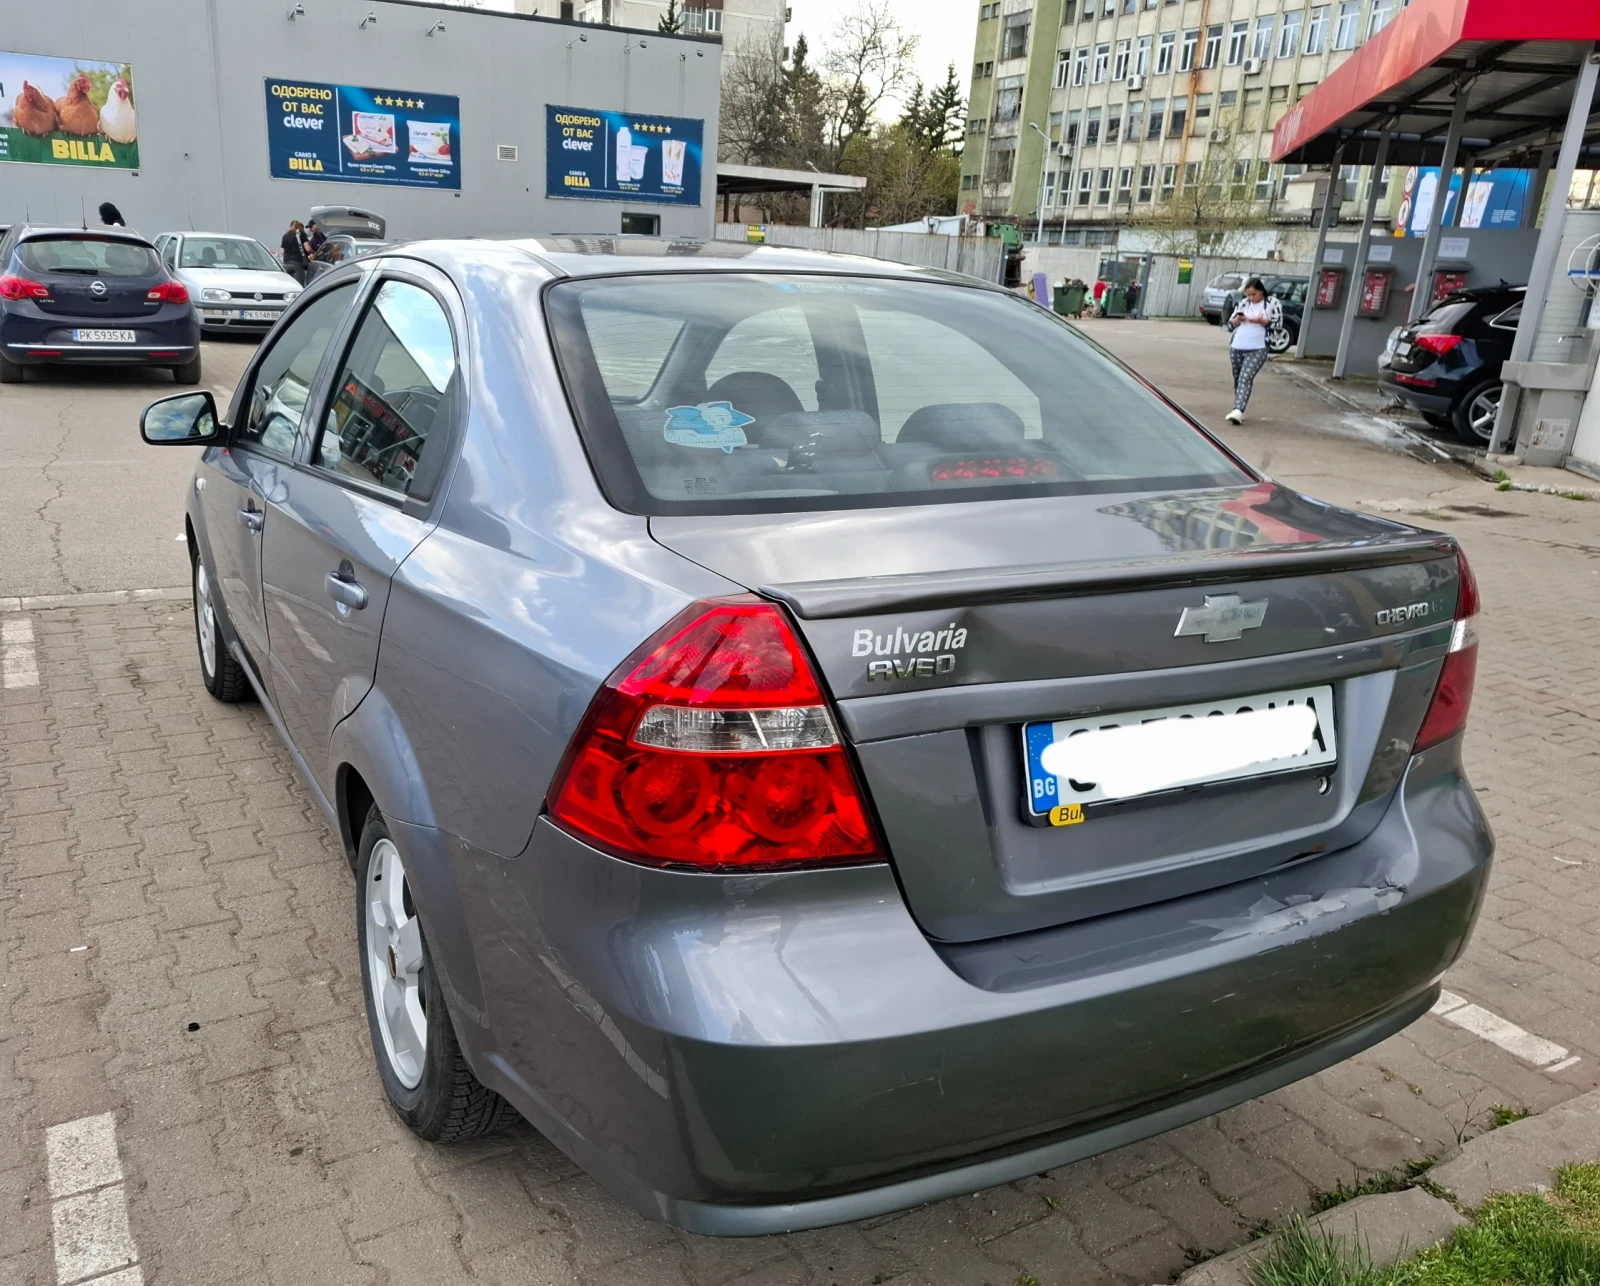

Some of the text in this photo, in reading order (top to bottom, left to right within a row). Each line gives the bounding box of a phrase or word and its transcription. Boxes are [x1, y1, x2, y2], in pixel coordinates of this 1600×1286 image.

[272, 85, 332, 100] ОДОБРЕНО
[282, 101, 323, 114] ОТ ВАС
[283, 114, 324, 130] clever
[555, 114, 601, 126] ОДОБРЕНО
[562, 128, 593, 138] ОТ ВАС
[51, 139, 116, 162] BILLA
[562, 138, 593, 151] clever
[288, 158, 324, 171] BILLA
[564, 176, 590, 187] BILLA
[79, 330, 134, 340] PK 5935 KA
[852, 623, 968, 657] Bulvaria
[867, 654, 956, 682] AVEO
[1033, 777, 1056, 798] BG
